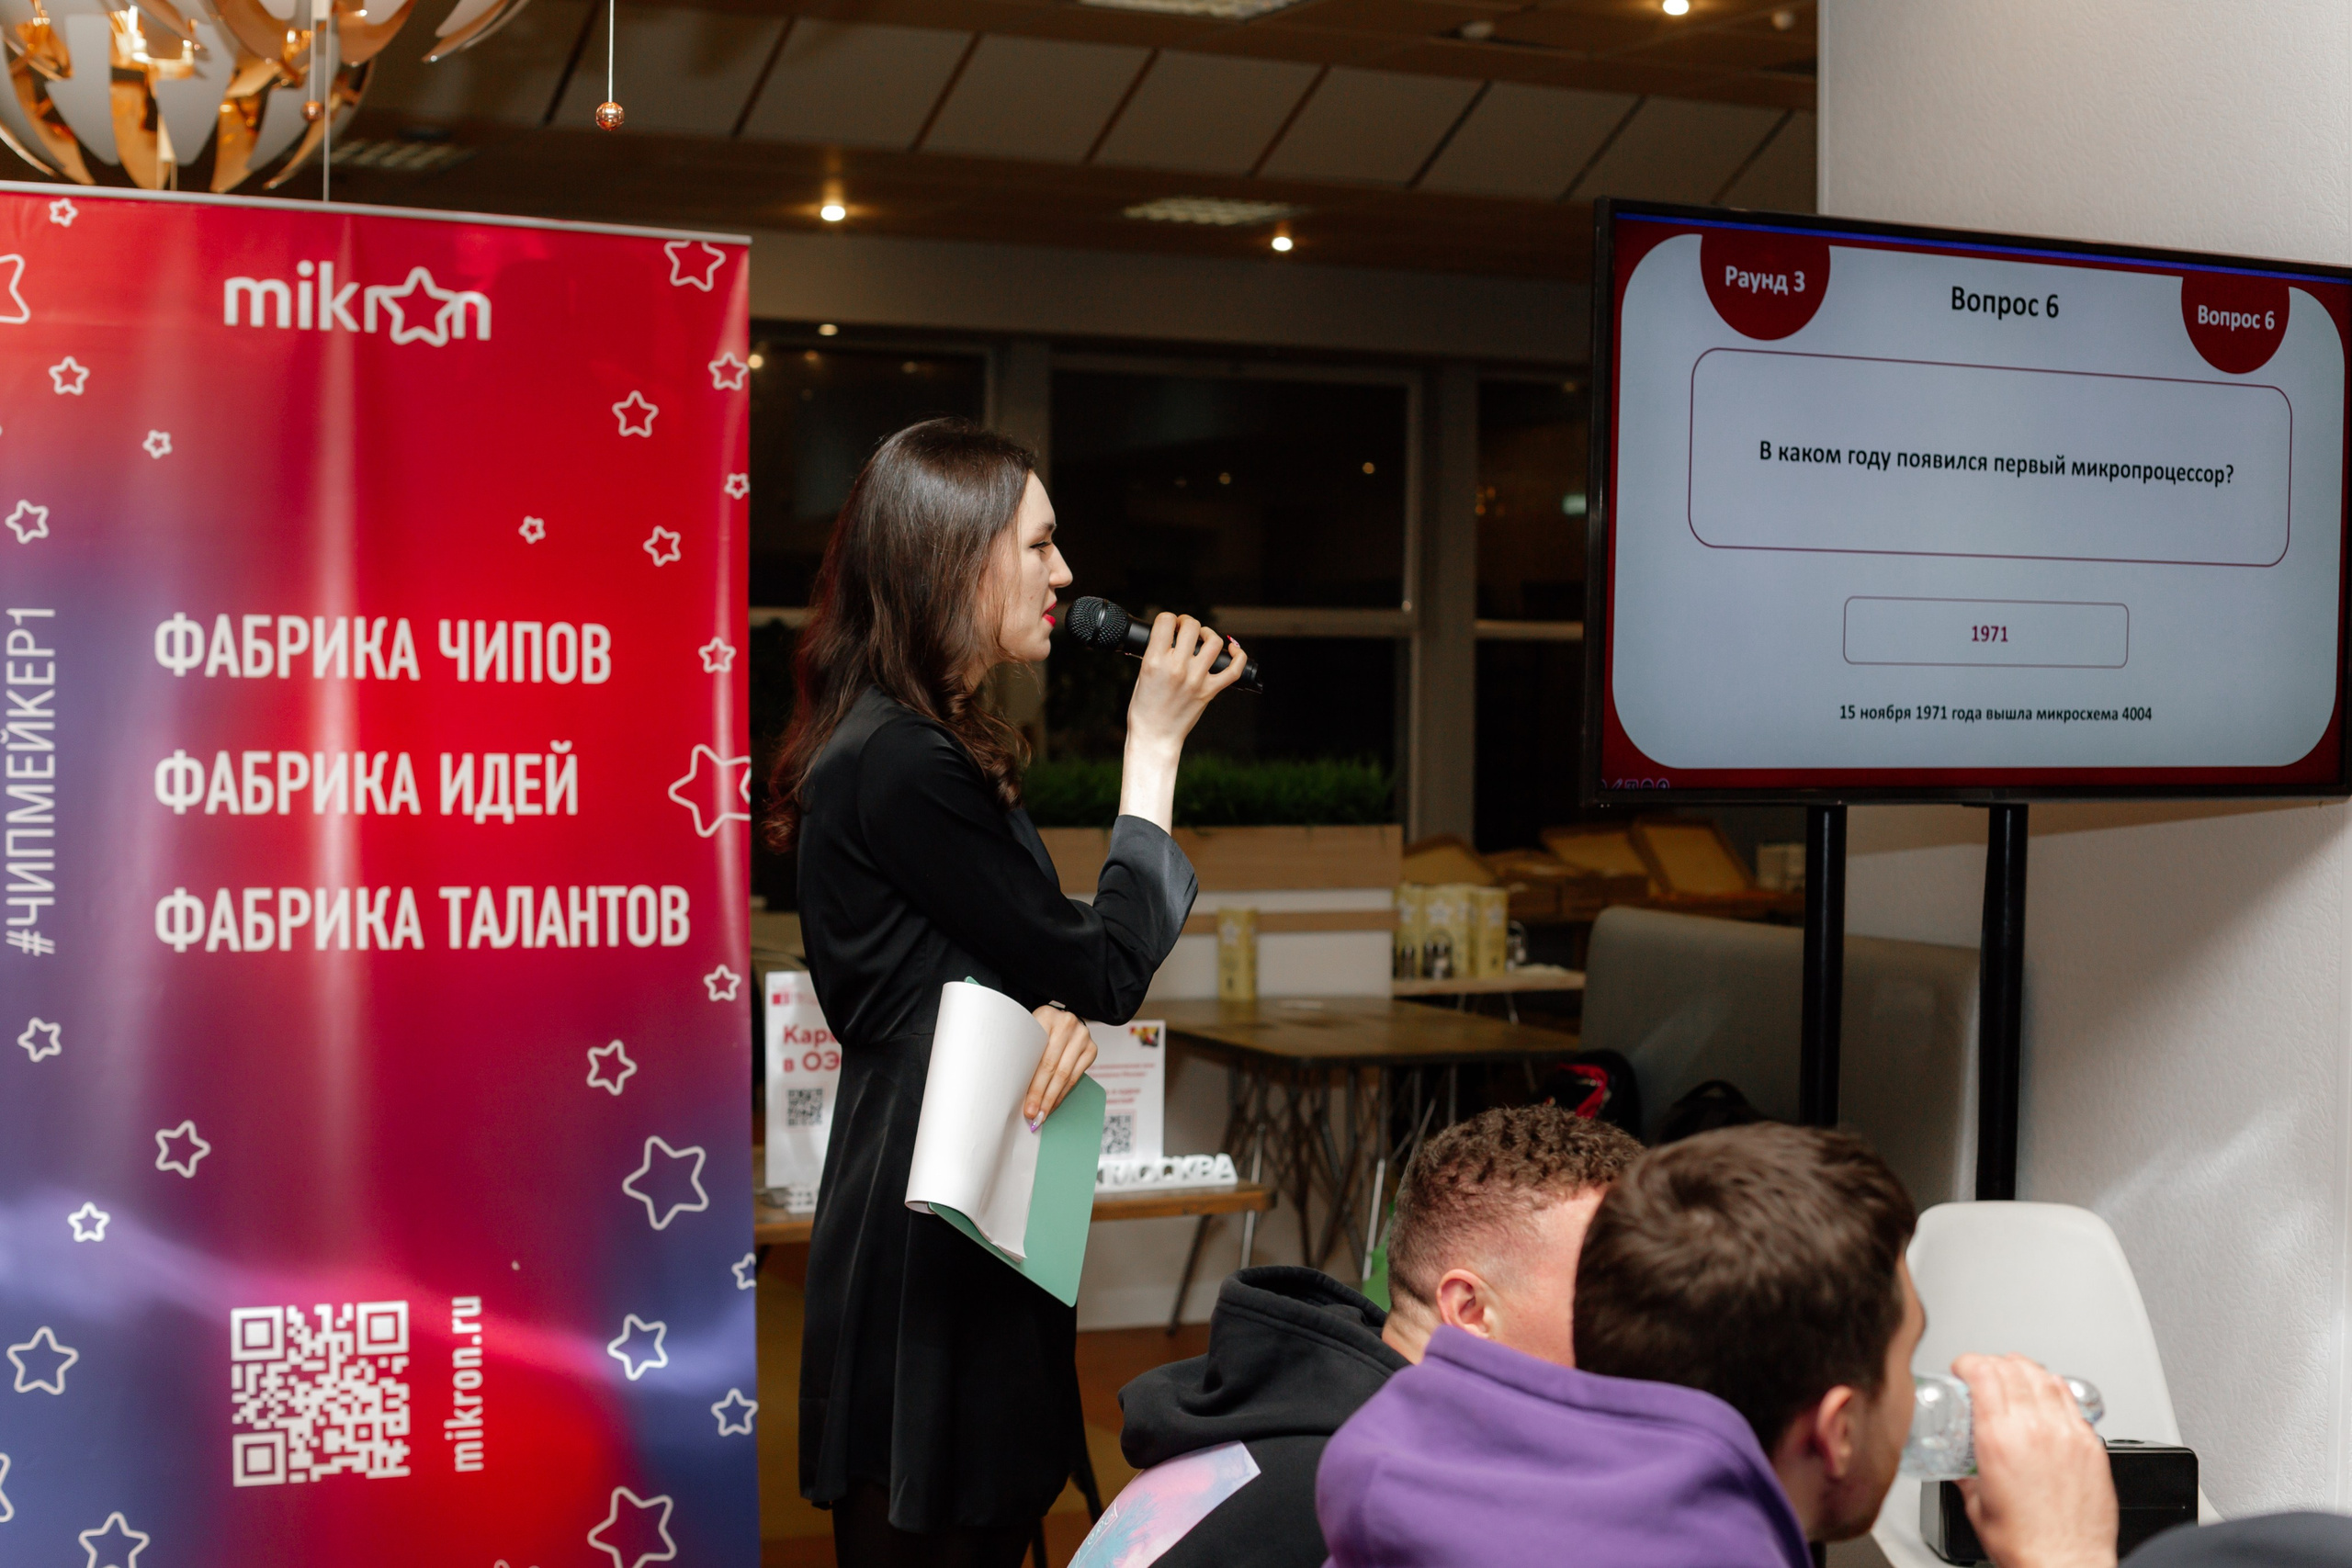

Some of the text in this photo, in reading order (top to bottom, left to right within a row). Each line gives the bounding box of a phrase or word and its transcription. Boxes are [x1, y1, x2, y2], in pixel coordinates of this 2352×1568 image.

[1724, 265, 1806, 295] Раунд 3
[1951, 285, 2061, 321] Вопрос 6
[2197, 304, 2276, 332] Вопрос 6
[1758, 439, 2235, 489] В каком году появился первый микропроцессор?
[153, 613, 612, 684] ФАБРИКА ЧИПОВ
[1971, 624, 2009, 643] 1971
[1838, 704, 2153, 724] 15 ноября 1971 года вышла микросхема 4004
[0, 607, 56, 957] #ЧИПМЕЙКЕР1
[153, 741, 578, 823] ФАБРИКА ИДЕЙ
[154, 886, 690, 952] ФАБРИКА ТАЛАНТОВ
[445, 1296, 483, 1472] mikron.ru
